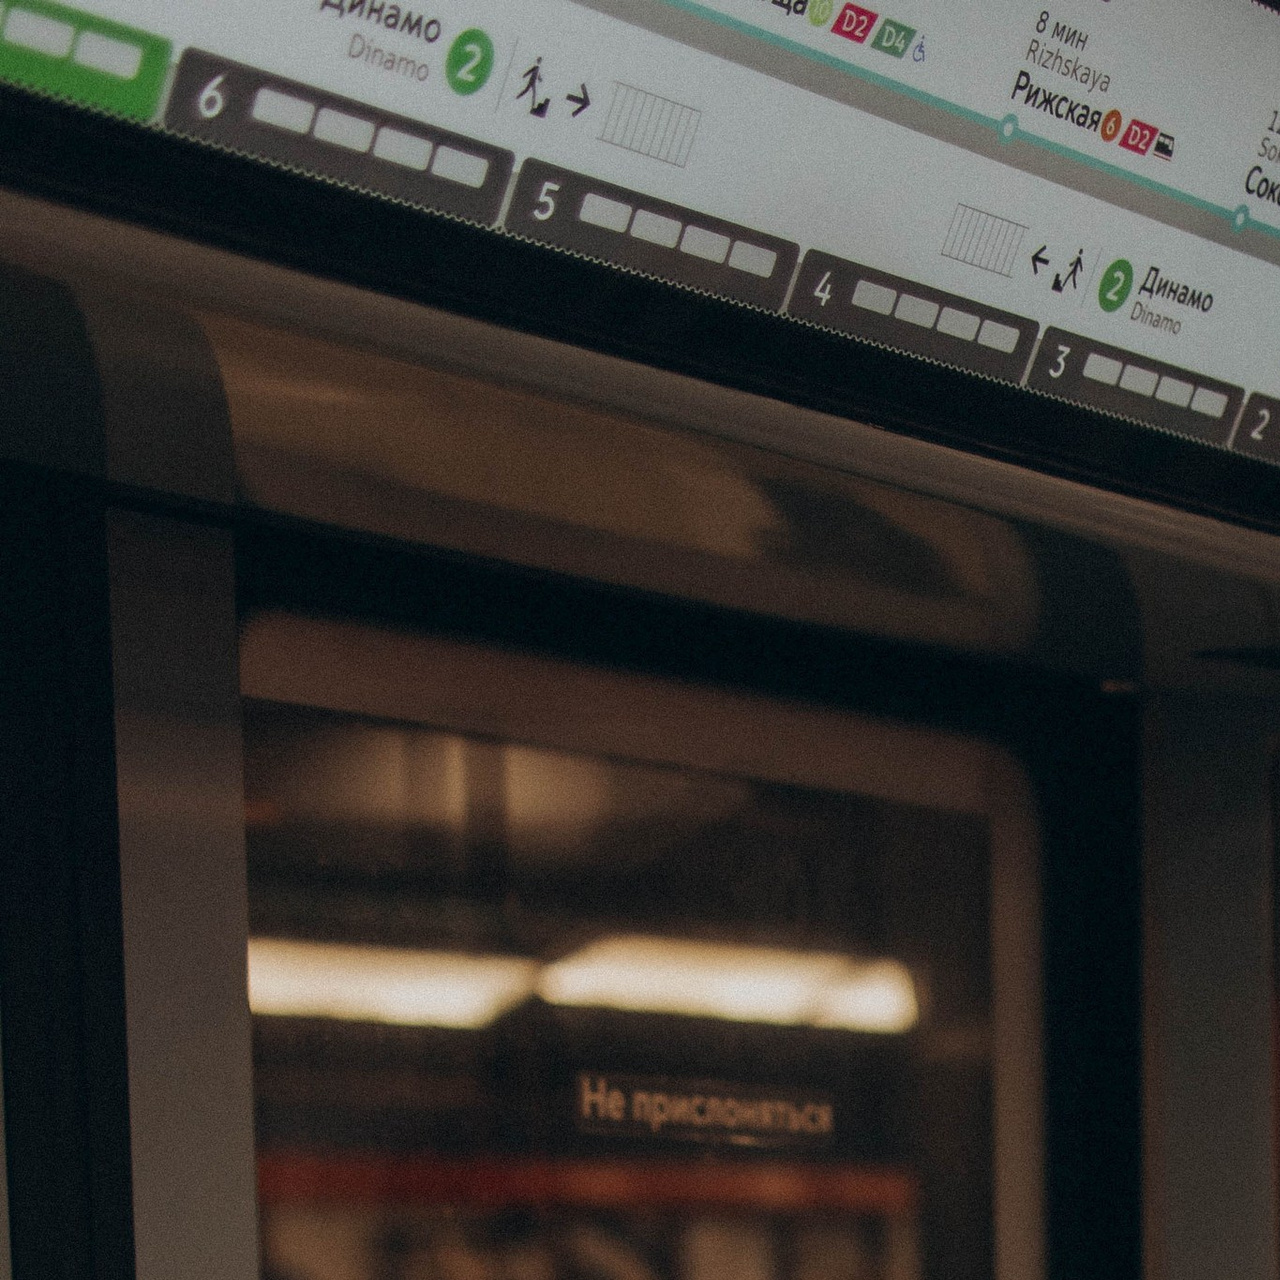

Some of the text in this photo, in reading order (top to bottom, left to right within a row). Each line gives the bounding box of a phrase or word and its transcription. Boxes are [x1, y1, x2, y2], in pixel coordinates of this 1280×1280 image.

[841, 9, 868, 37] D2
[881, 25, 906, 53] D4
[1035, 10, 1089, 51] 8 мин
[349, 33, 429, 81] Dinamo
[457, 43, 482, 82] 2
[1025, 38, 1111, 93] Rizhskaya
[198, 71, 227, 118] 6
[1011, 70, 1150, 150] Рижская 6 D2
[533, 181, 560, 221] 5
[813, 271, 832, 307] 4
[1106, 270, 1125, 301] 2
[1138, 266, 1214, 312] Динамо
[1130, 301, 1182, 335] Dinamo
[1048, 343, 1071, 379] 3
[1250, 408, 1270, 440] 2
[579, 1074, 625, 1122] Не
